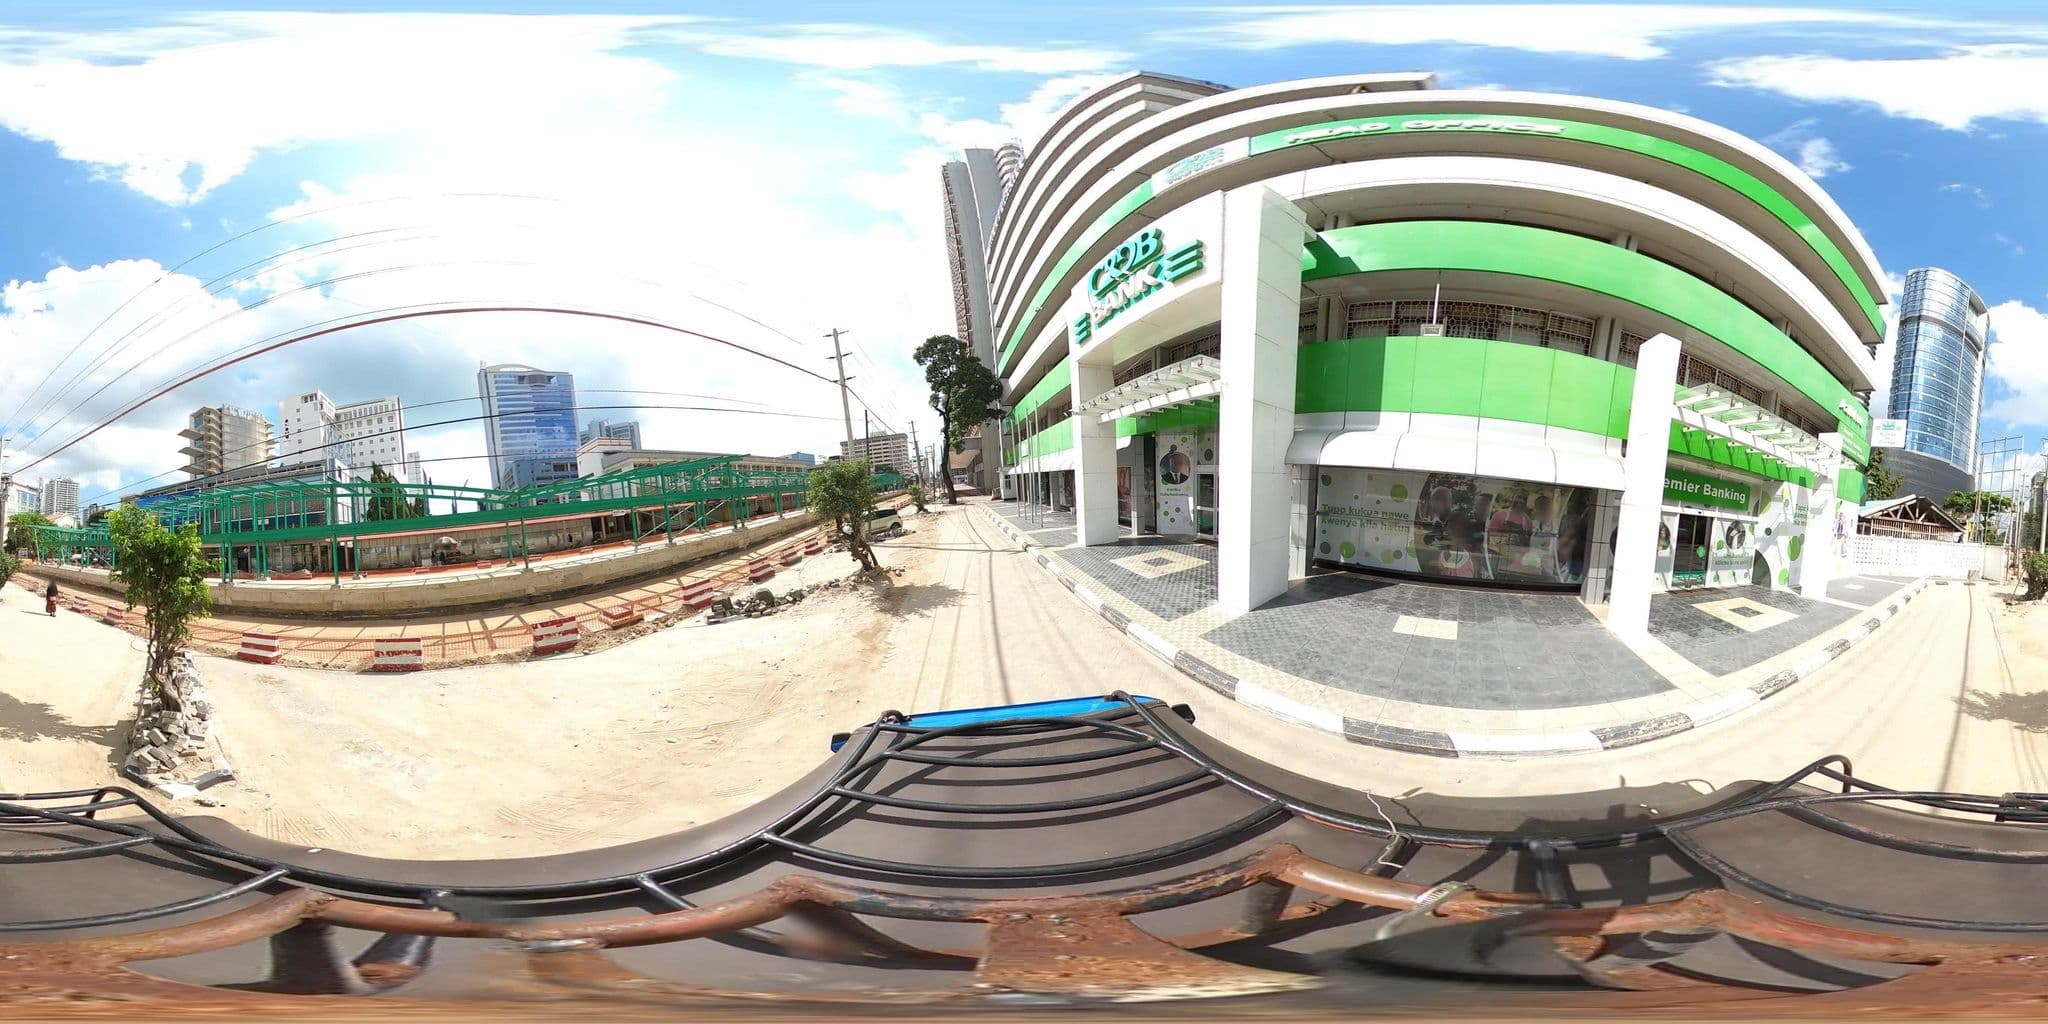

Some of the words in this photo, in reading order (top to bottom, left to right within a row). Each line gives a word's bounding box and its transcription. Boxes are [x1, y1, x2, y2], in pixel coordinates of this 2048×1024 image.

[1402, 119, 1566, 135] OFFICE
[1093, 262, 1163, 329] BANK
[1703, 484, 1746, 504] Banking
[1321, 503, 1346, 514] Tupo
[1381, 511, 1409, 520] nawe
